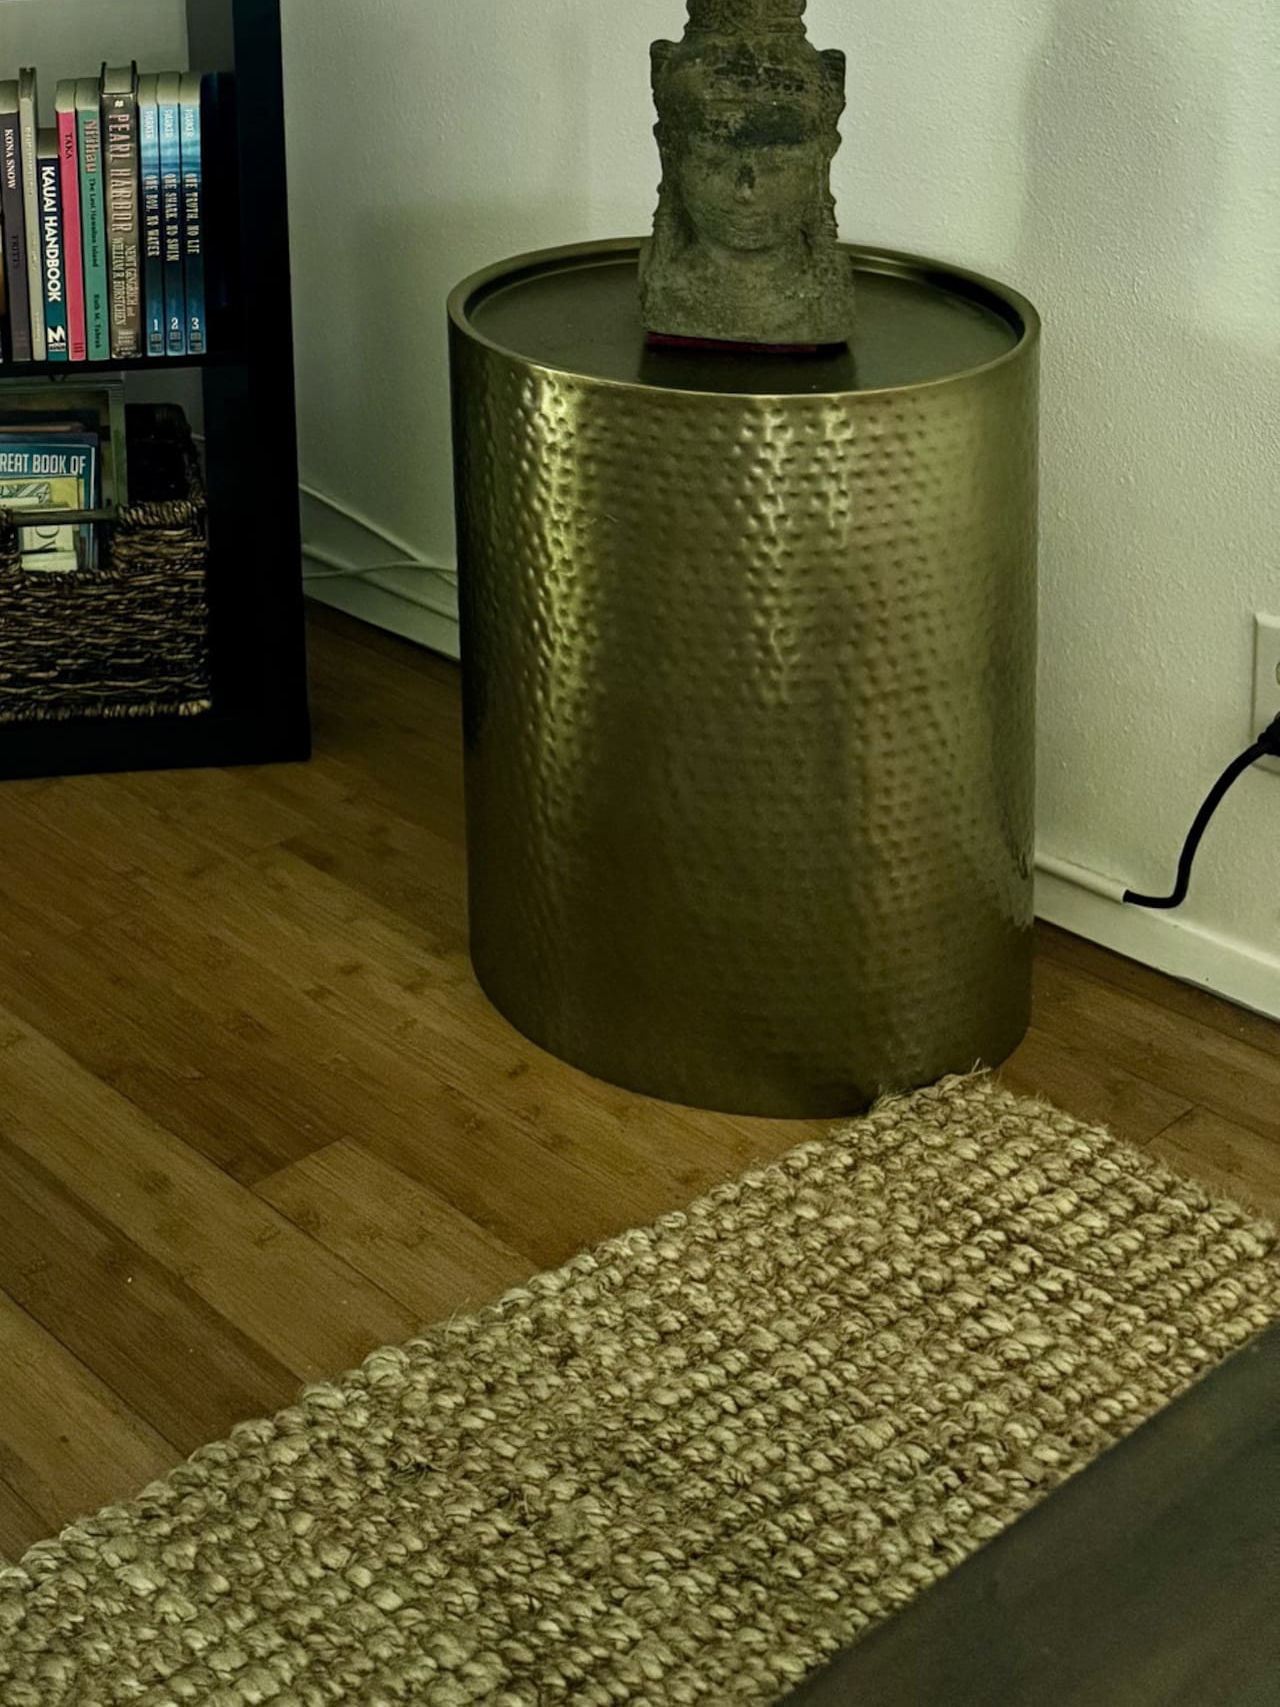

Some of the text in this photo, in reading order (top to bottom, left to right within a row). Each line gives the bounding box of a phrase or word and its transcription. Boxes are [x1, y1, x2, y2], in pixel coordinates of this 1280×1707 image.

[4, 128, 14, 158] KONA
[64, 133, 74, 160] TAKA
[5, 159, 17, 190] SNOW
[109, 114, 133, 232] PEARL HARBOR
[165, 173, 177, 189] ONE
[145, 175, 158, 190] ONE
[41, 165, 61, 303] KAUAI HANDBOOK
[187, 239, 200, 254] LIE
[153, 318, 159, 331] 1
[171, 317, 179, 330] 2
[191, 317, 200, 330] 3
[32, 454, 67, 474] BOOK
[71, 455, 87, 475] OF
